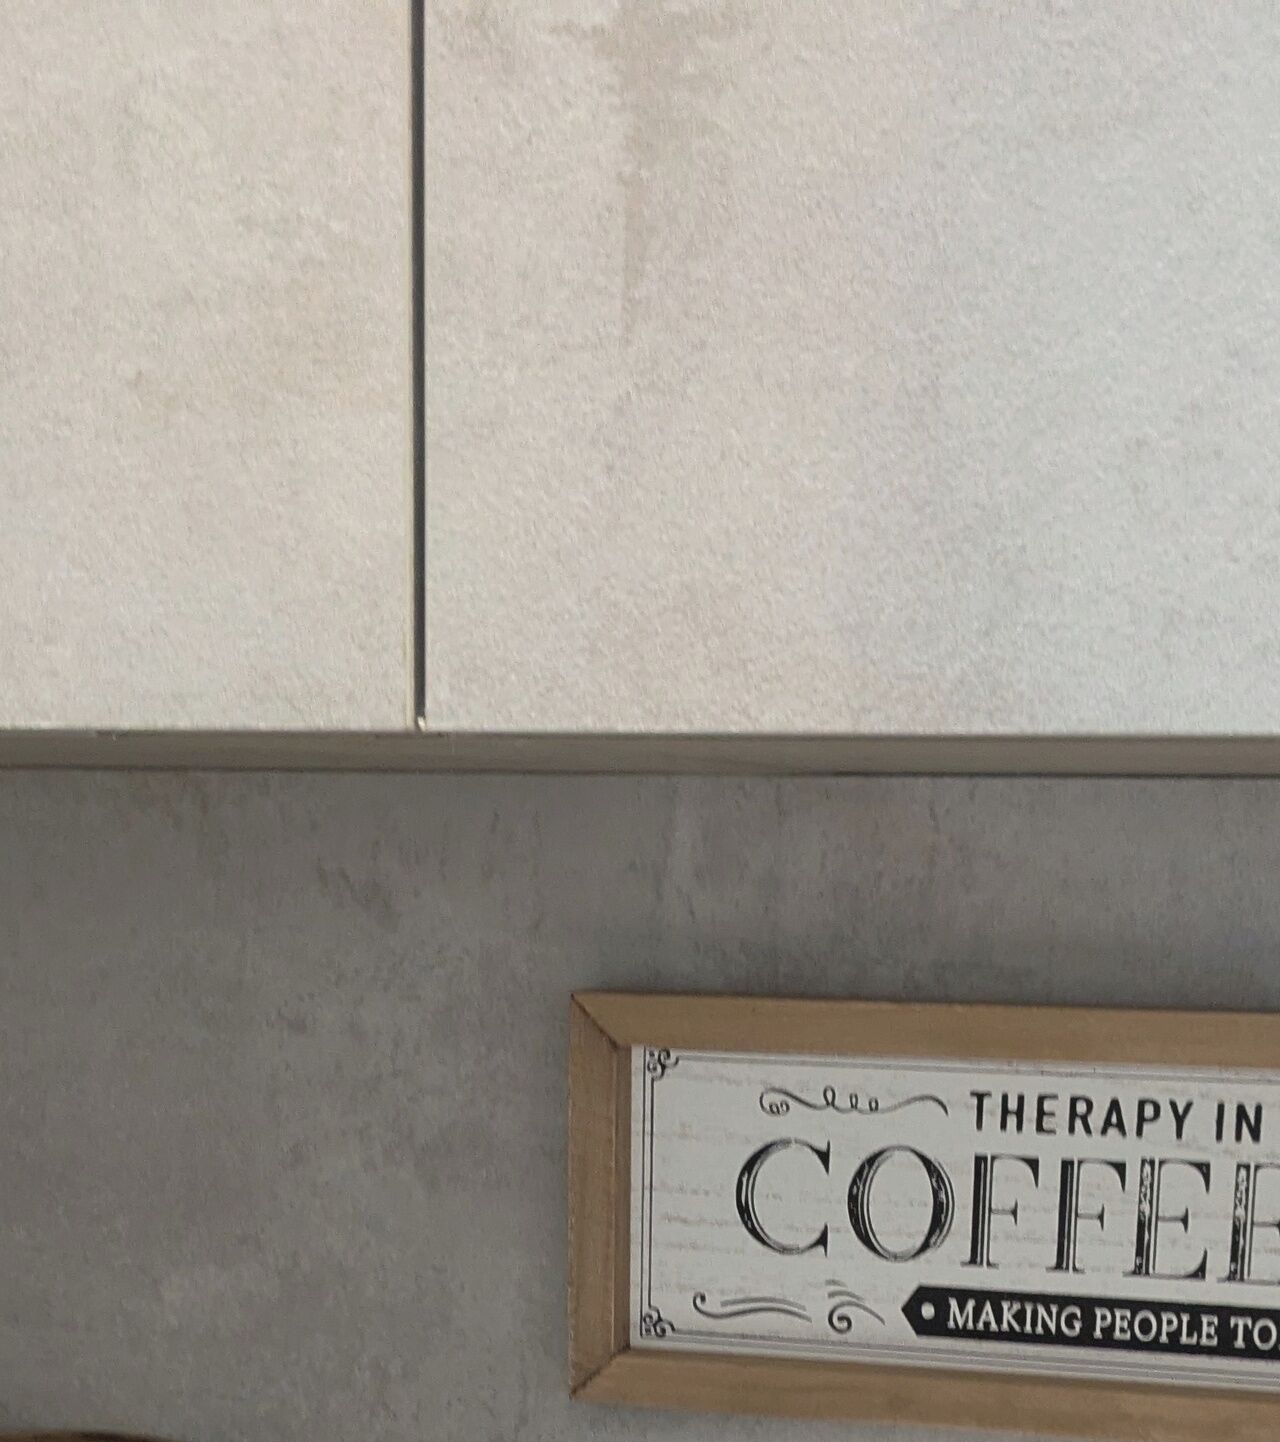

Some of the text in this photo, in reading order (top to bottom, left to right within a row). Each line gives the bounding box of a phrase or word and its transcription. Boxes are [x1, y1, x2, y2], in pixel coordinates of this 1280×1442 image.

[969, 1089, 1195, 1142] THERAPY
[1215, 1100, 1264, 1144] IN
[946, 1296, 1083, 1338] MAKING
[1093, 1306, 1219, 1347] PEOPLE
